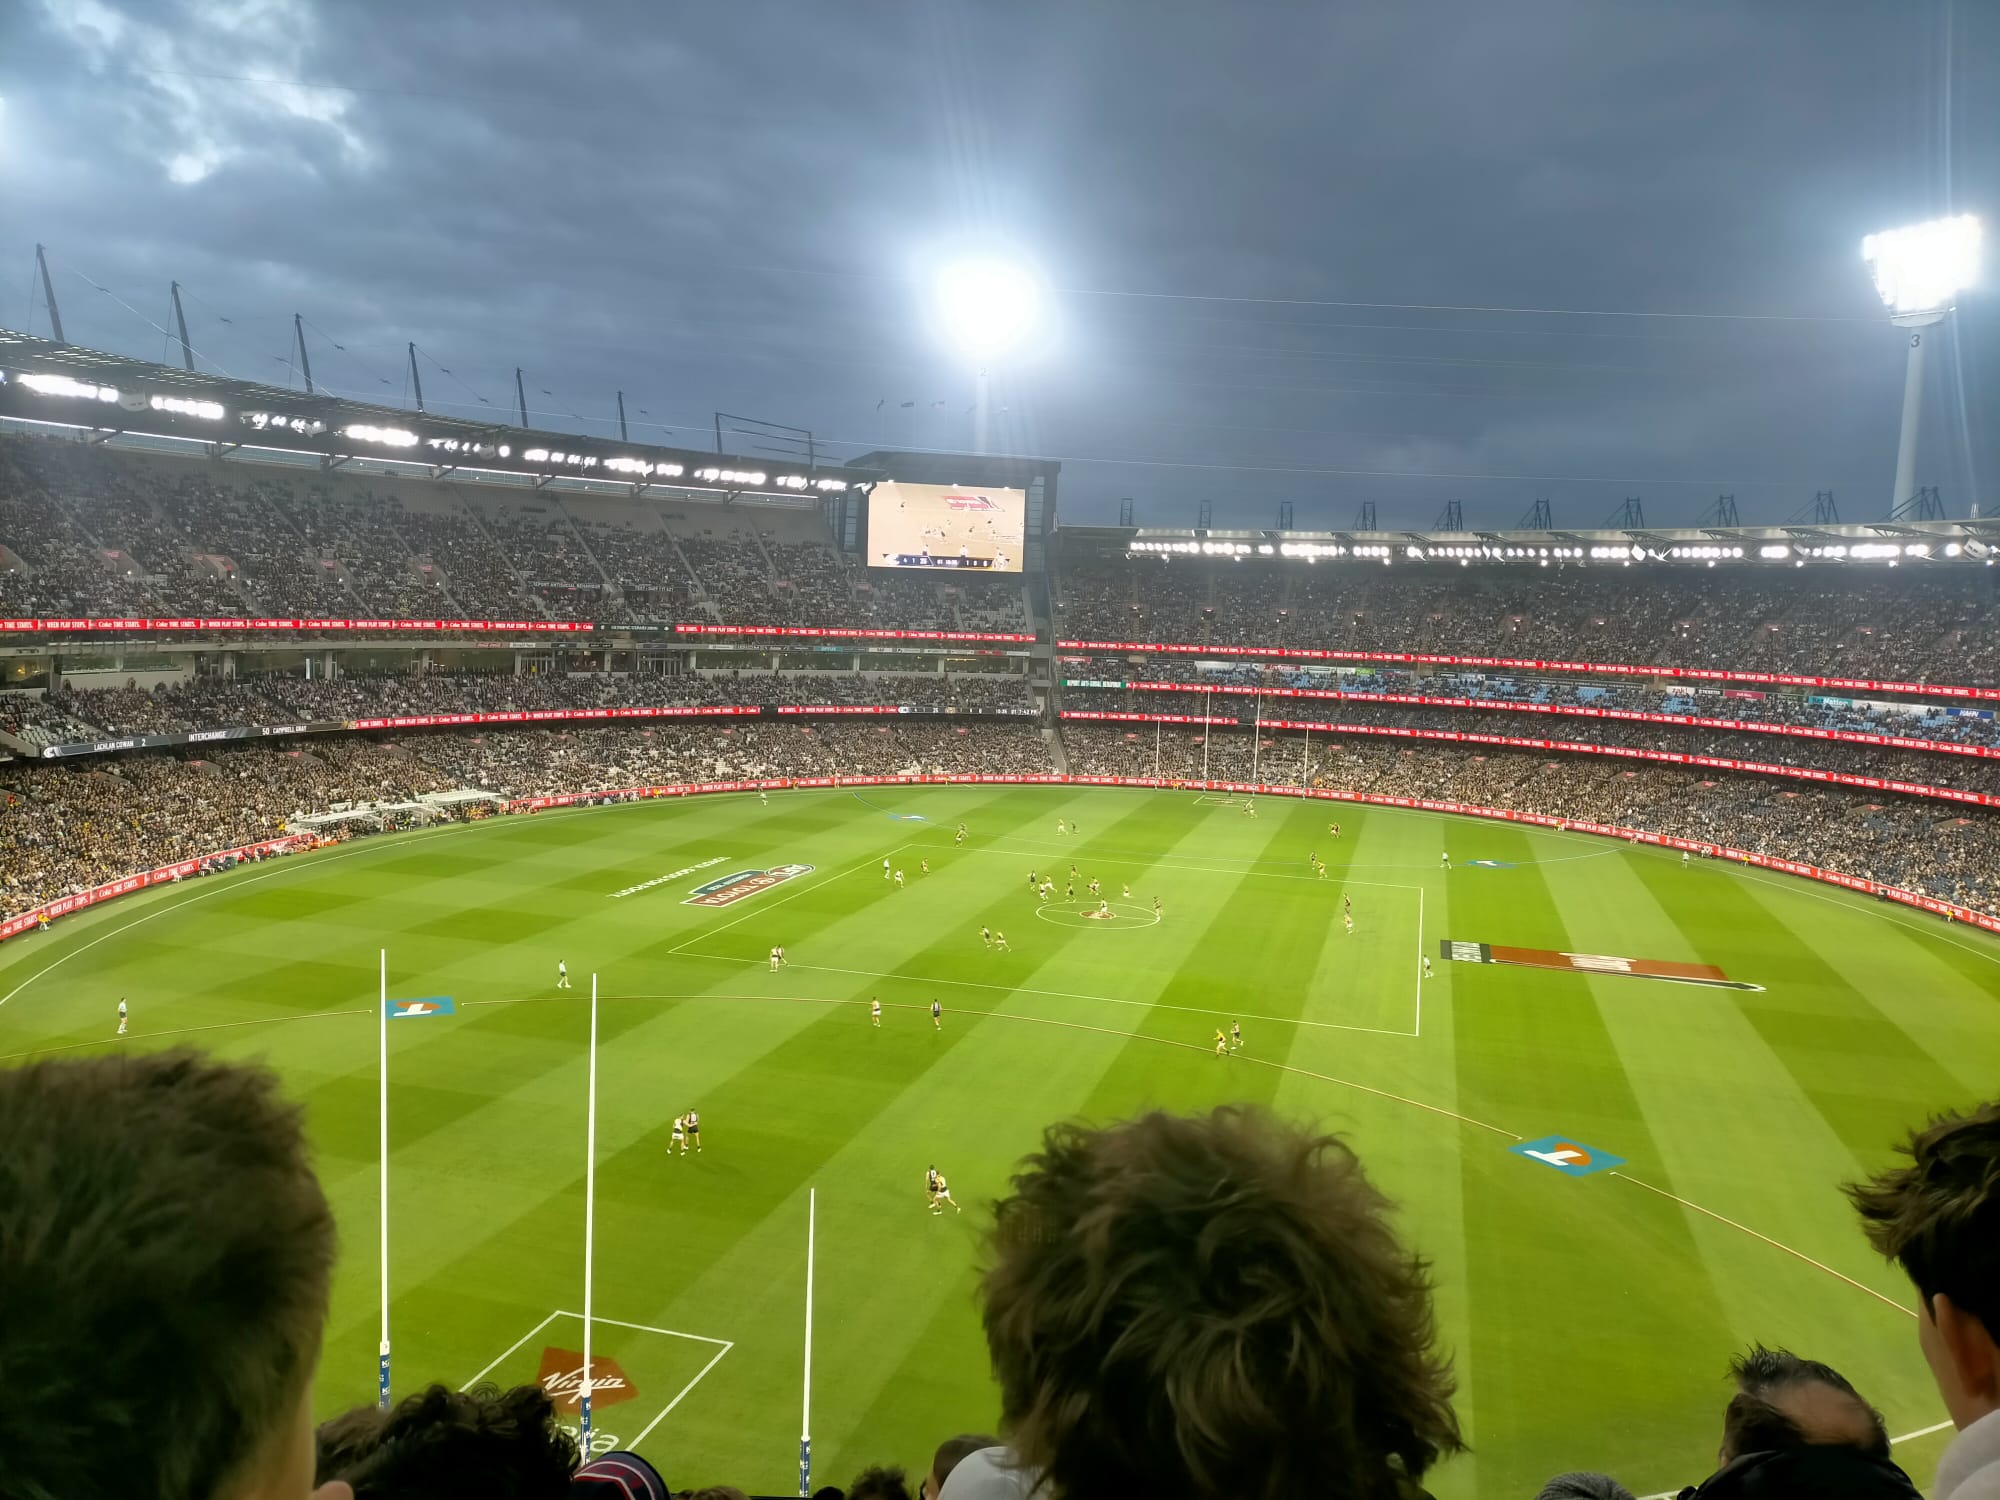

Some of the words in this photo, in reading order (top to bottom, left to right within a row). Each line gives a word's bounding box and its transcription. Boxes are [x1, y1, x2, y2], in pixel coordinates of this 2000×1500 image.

[1910, 334, 1920, 348] 3
[142, 738, 146, 746] 2
[188, 730, 226, 742] INTERCHANGE
[542, 1364, 626, 1404] Virgin
